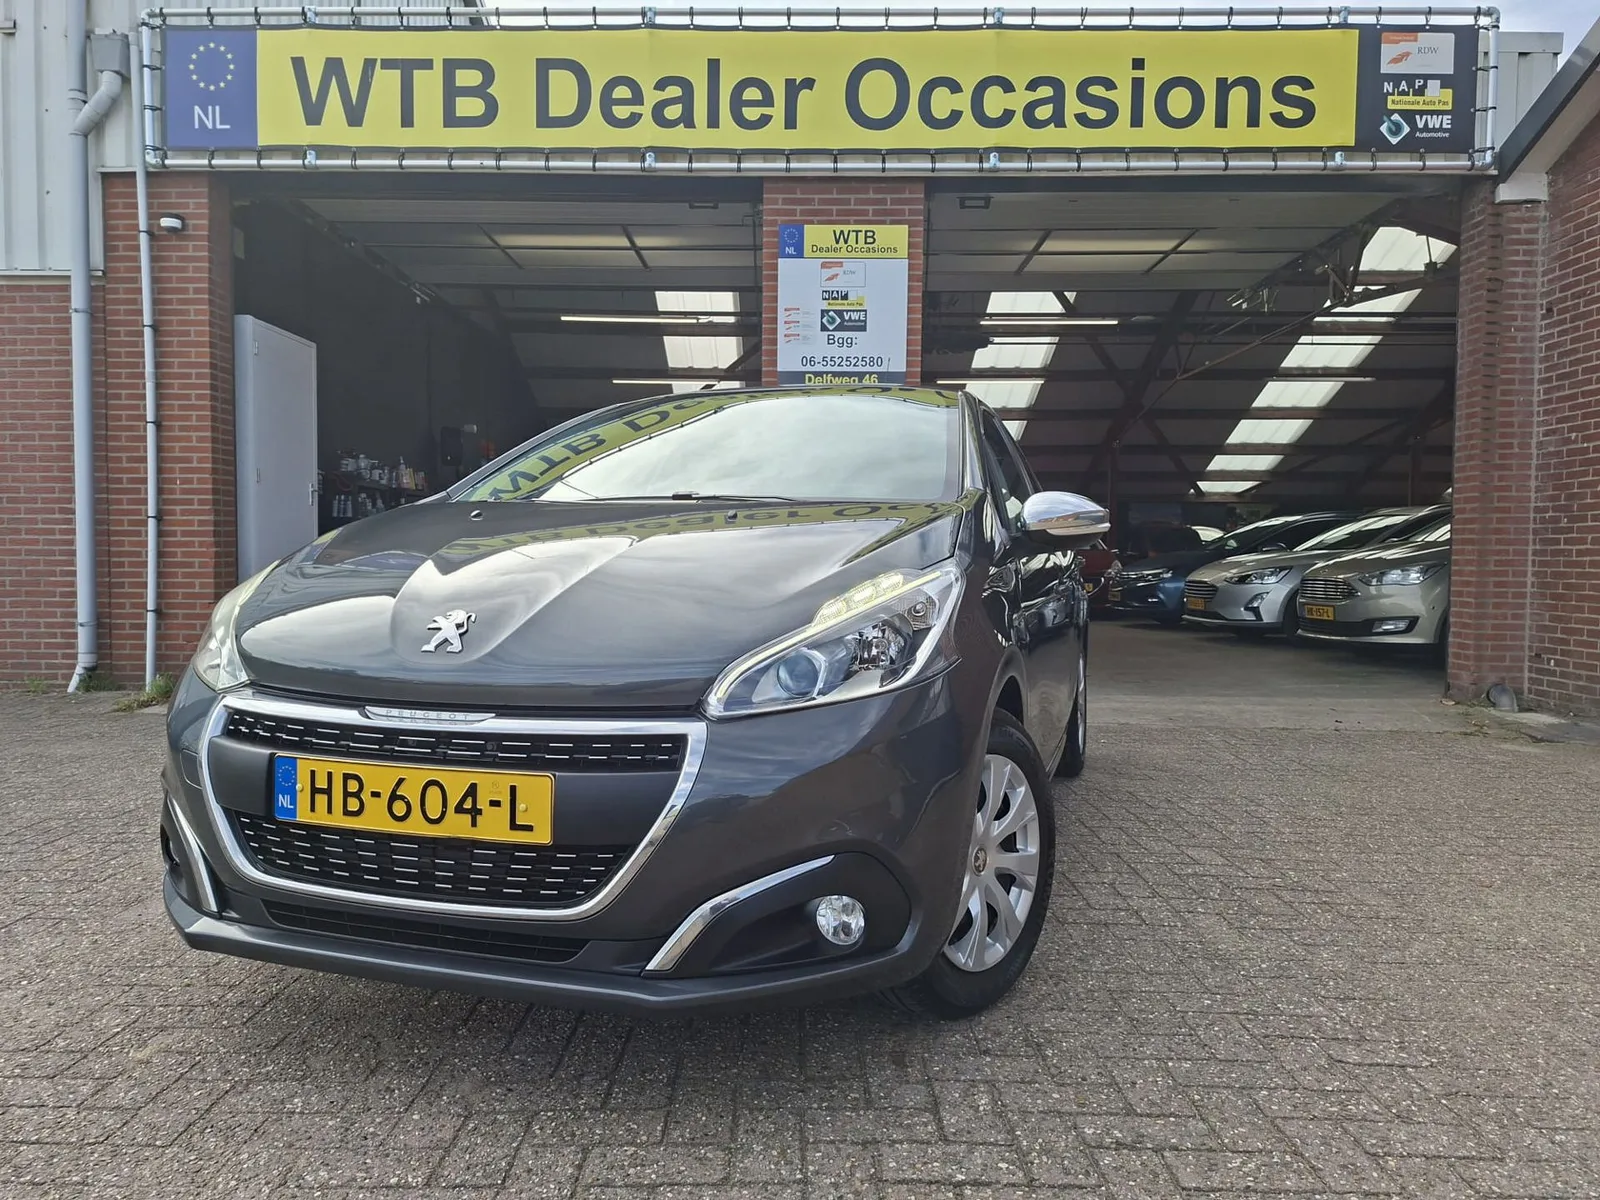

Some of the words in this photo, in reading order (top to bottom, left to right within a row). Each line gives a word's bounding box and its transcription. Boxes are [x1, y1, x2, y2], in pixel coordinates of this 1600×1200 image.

[1417, 46, 1439, 54] RDW
[290, 56, 500, 129] WTB
[535, 57, 816, 130] Dealer
[845, 57, 1316, 130] Occasions
[1391, 98, 1420, 106] Nationale
[1422, 98, 1436, 106] Auto
[1438, 98, 1449, 106] Pas
[193, 105, 231, 130] NL
[1415, 115, 1452, 128] VWE
[833, 230, 876, 245] WTB
[785, 247, 797, 255] NL
[811, 245, 843, 254] Dealer
[845, 245, 898, 254] Occasions
[843, 311, 866, 320] VWE
[827, 334, 858, 348] Bgg:
[801, 356, 883, 367] 06-55252580
[862, 374, 878, 384] 46
[385, 709, 470, 720] PEUGEOT
[278, 794, 294, 809] NL
[309, 769, 534, 832] HB-604-L
